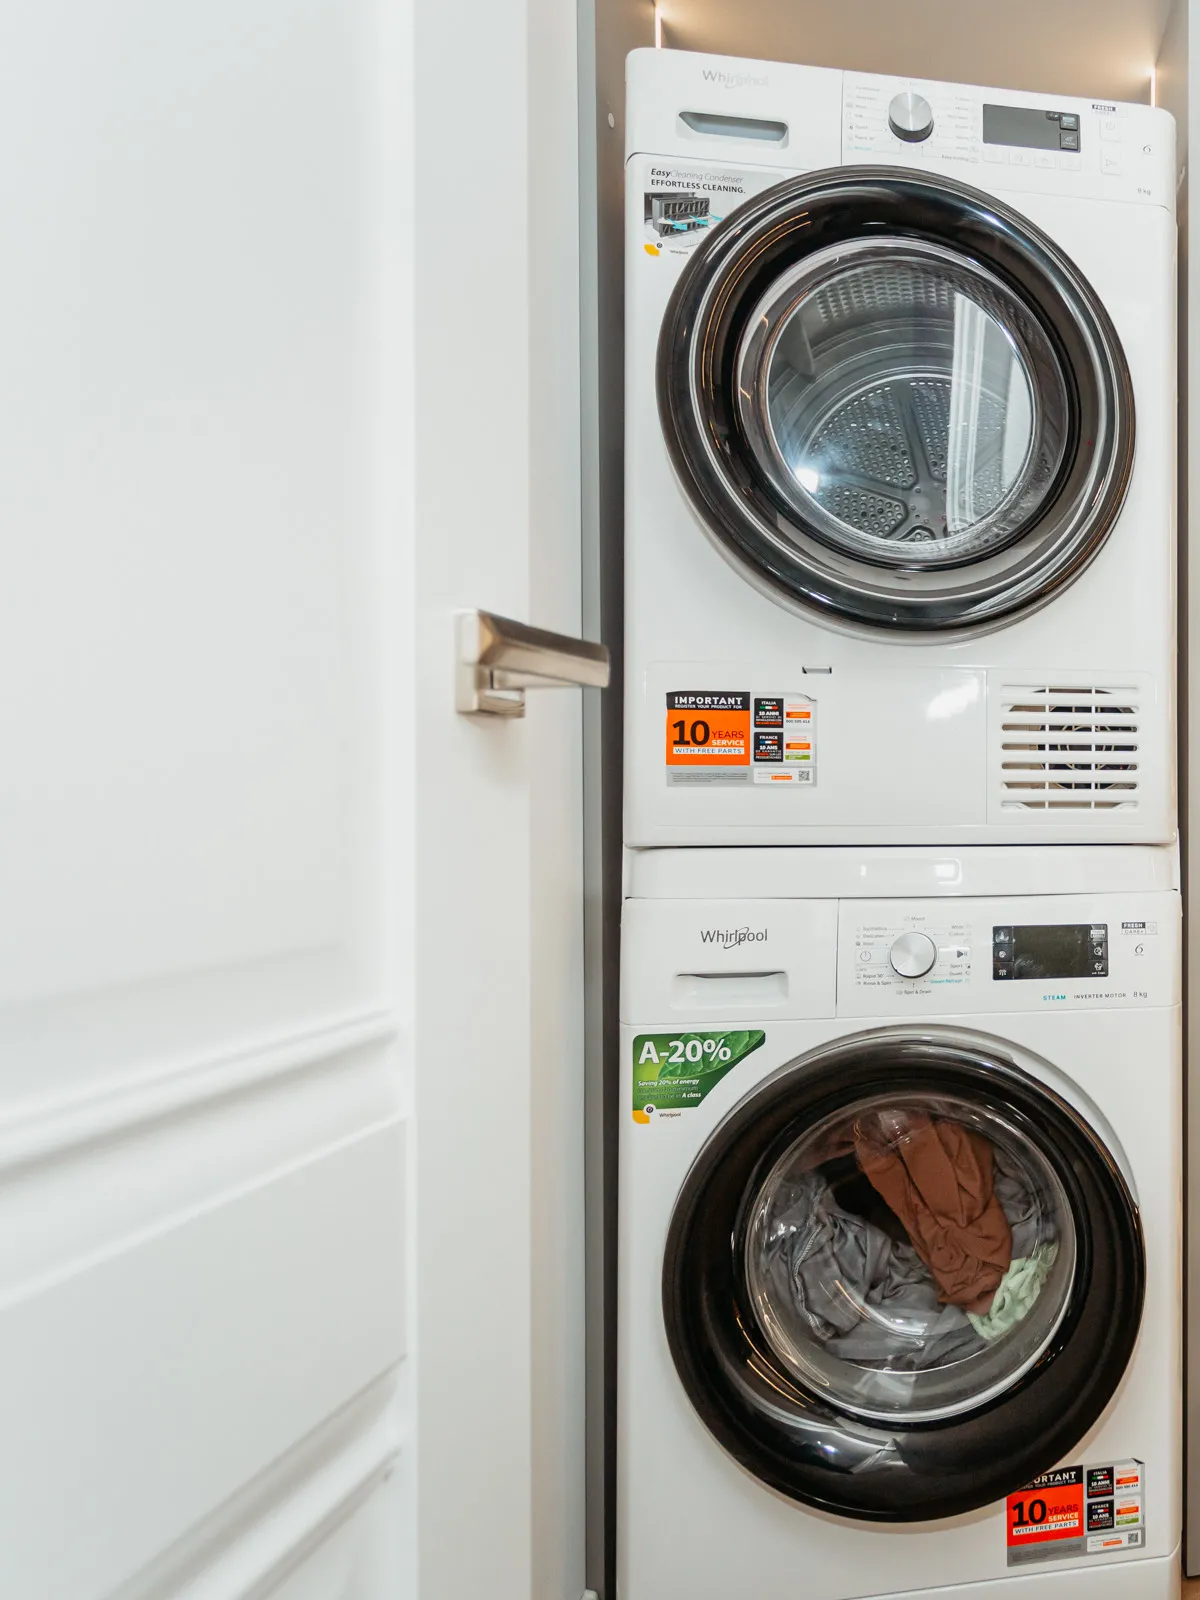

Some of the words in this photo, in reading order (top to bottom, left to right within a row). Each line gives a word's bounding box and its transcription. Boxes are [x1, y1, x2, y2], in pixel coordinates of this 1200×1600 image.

[704, 174, 744, 184] Condenser
[651, 179, 701, 190] EFFORTLESS
[702, 183, 746, 194] CLEANING.
[674, 696, 743, 705] IMPORTANT
[672, 719, 710, 746] 10
[712, 730, 745, 739] YEARS
[711, 739, 745, 747] SERVICE
[700, 927, 768, 949] Whirlpool
[1139, 991, 1148, 999] kg
[638, 1038, 732, 1064] A-20%
[1033, 1471, 1077, 1484] ORTANT
[1012, 1498, 1047, 1527] 10
[1048, 1503, 1079, 1515] YEARS
[1048, 1511, 1079, 1522] SERVICE
[1014, 1526, 1034, 1535] WITH
[1035, 1524, 1052, 1532] FREE
[1054, 1520, 1077, 1529] PARTS
